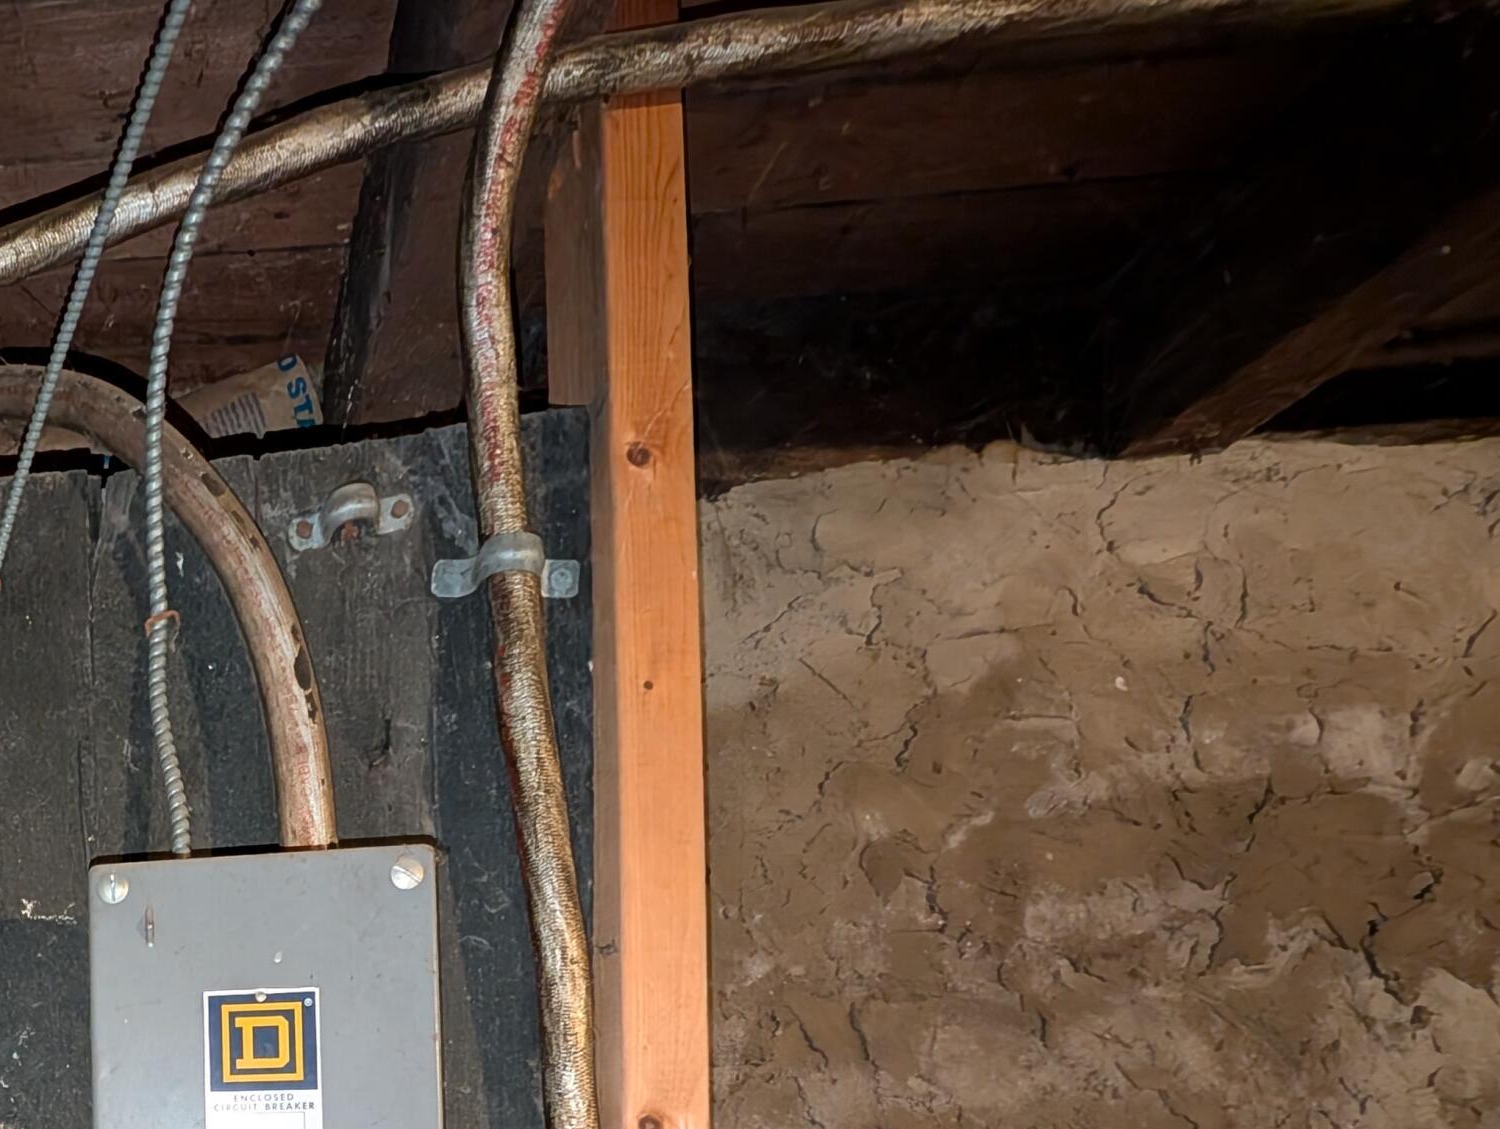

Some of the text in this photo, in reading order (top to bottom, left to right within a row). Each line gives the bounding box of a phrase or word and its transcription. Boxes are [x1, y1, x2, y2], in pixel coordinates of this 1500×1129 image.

[234, 1093, 294, 1102] ENCLOSED
[214, 1101, 315, 1112] CIRCUIT BREAKER
